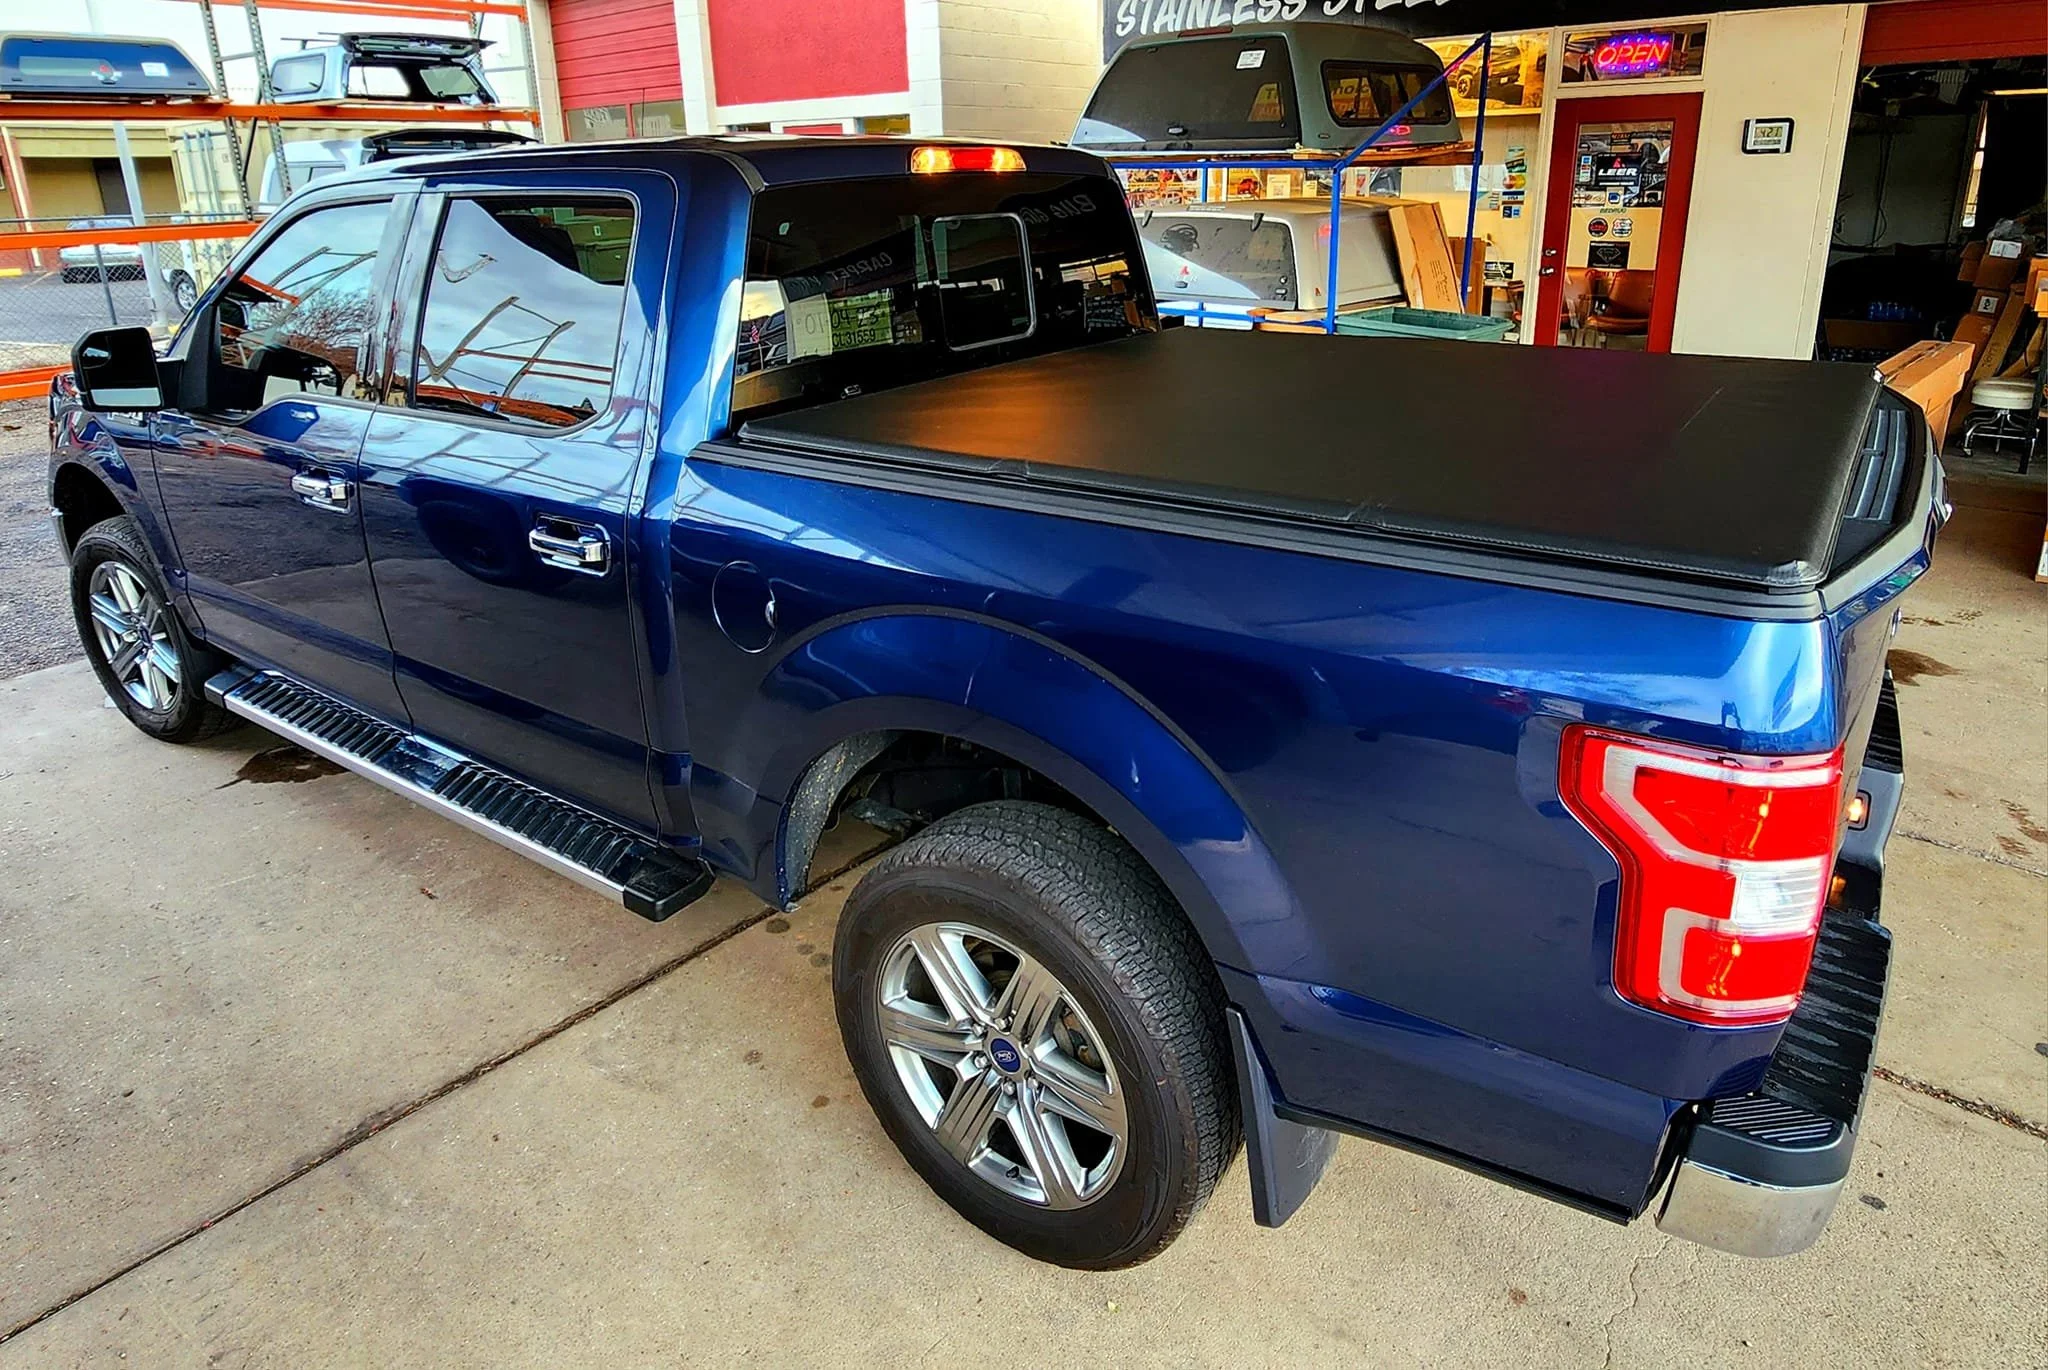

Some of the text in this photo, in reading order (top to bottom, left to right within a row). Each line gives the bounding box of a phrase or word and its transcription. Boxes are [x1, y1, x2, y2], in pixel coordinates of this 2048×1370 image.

[1115, 0, 1307, 36] STAINLESS
[1597, 43, 1669, 66] OPEN
[1598, 168, 1638, 176] LEER
